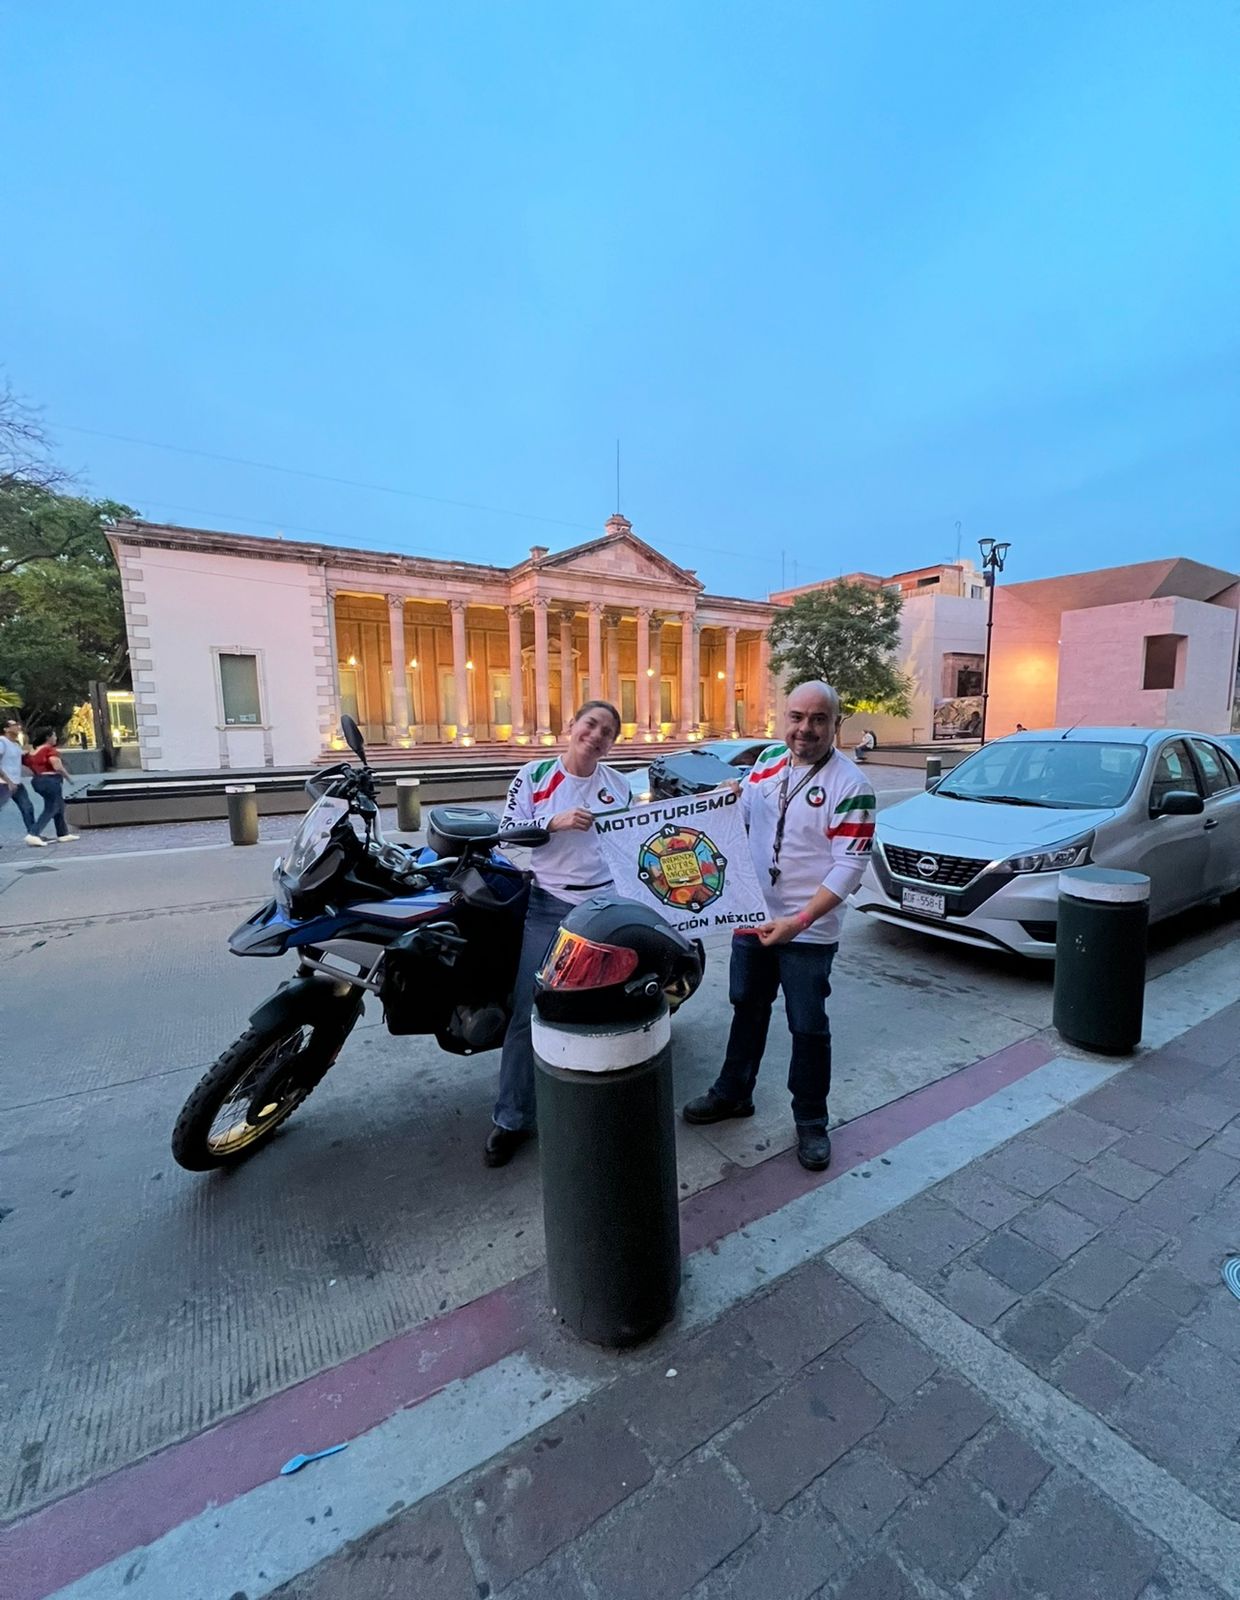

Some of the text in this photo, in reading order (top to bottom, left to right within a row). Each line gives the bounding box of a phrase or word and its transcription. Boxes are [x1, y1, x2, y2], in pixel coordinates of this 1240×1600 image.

[508, 778, 523, 811] BMW
[594, 792, 738, 835] MOTOTURISMO
[664, 826, 675, 835] N
[715, 857, 725, 866] E
[714, 911, 766, 926] MÉXICO
